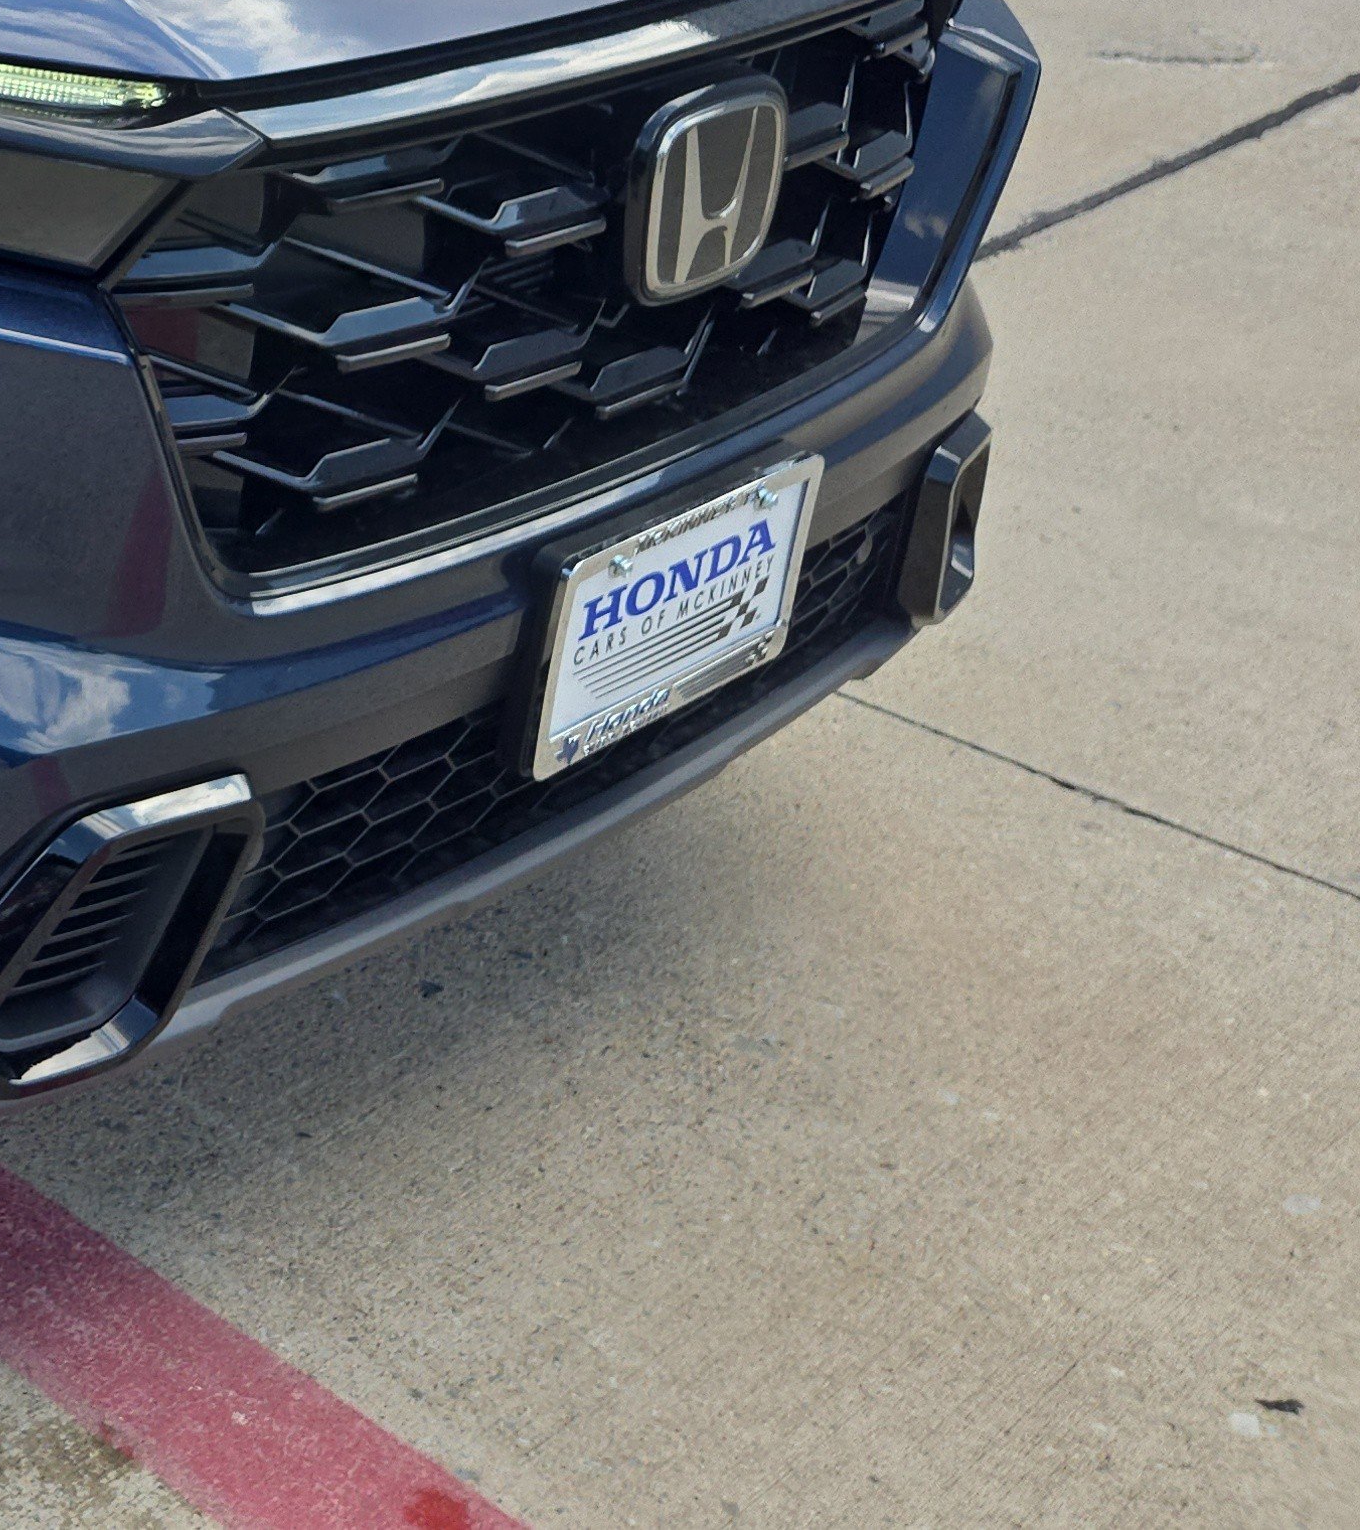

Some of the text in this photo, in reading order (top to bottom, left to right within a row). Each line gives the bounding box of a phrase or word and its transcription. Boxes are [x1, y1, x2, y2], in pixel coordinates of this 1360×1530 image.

[573, 554, 774, 666] CARS OF MCKINNEY
[578, 519, 776, 642] HONDA
